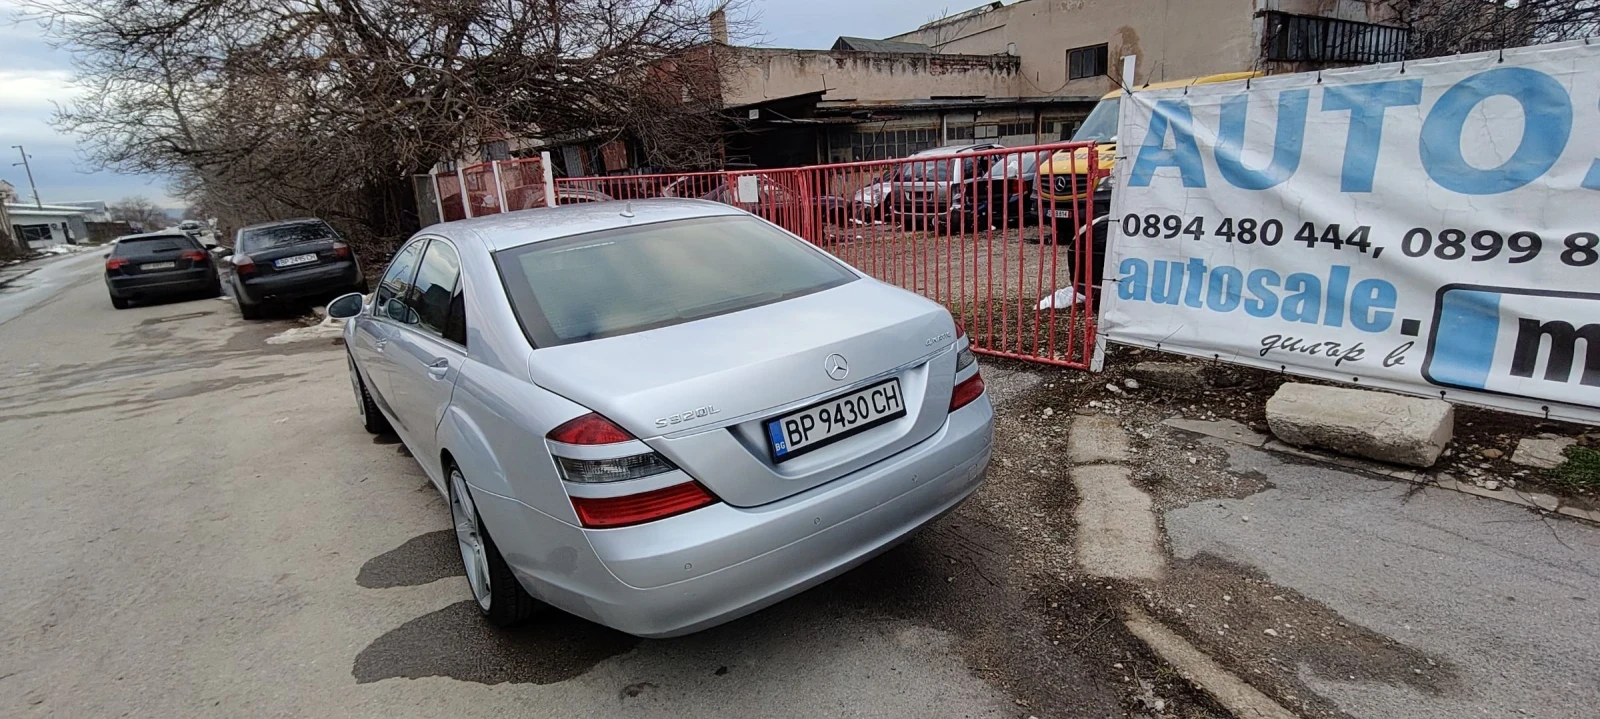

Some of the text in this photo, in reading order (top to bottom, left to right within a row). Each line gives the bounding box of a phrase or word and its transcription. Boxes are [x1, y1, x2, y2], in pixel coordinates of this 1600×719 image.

[1128, 66, 1600, 197] AUTO
[1122, 213, 1600, 267] 0894 480 444, 0899 8
[1259, 334, 1366, 367] дилър
[785, 384, 900, 447] BP 9430 CH
[775, 443, 786, 452] BG
